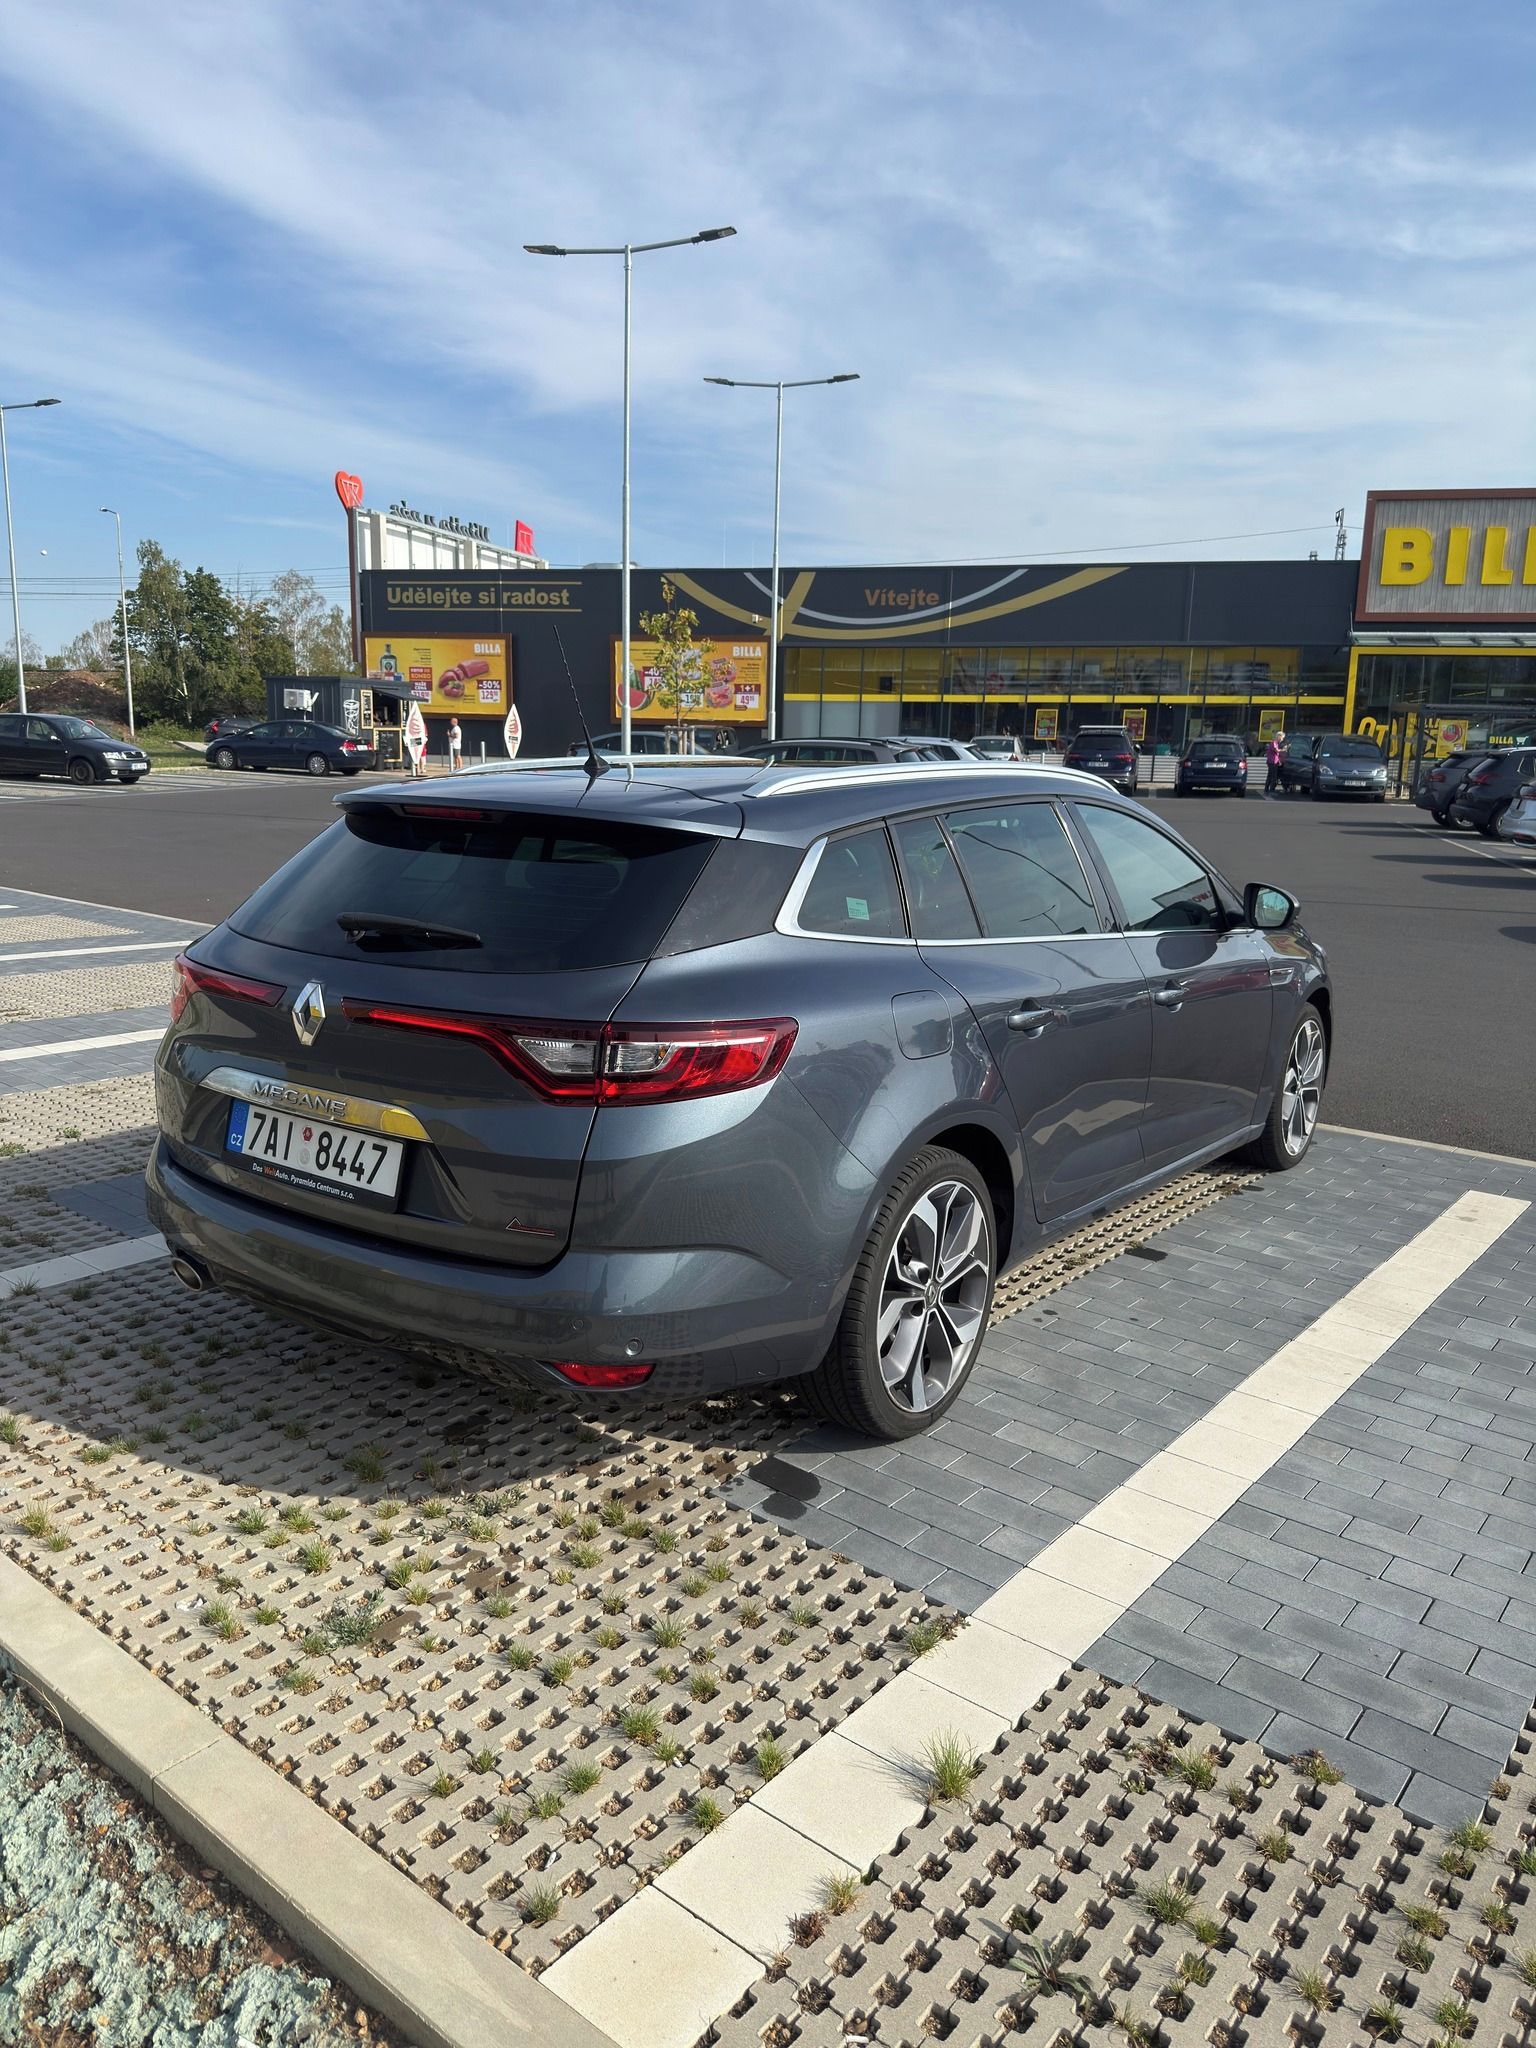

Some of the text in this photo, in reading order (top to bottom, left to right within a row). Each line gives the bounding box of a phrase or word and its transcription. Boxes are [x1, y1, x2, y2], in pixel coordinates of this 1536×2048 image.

[1380, 526, 1536, 585] BIL
[387, 587, 570, 609] Udělejte si radost
[863, 588, 940, 610] Vítejte
[474, 643, 501, 654] BILLA
[733, 646, 762, 657] BILLA
[478, 680, 500, 689] -50%
[1489, 736, 1514, 745] BILLA
[252, 1080, 347, 1117] MEGANE
[230, 1133, 242, 1147] CZ
[315, 1131, 388, 1185] 8447
[252, 1163, 263, 1173] Das
[290, 1174, 316, 1188] Pyramida
[316, 1182, 340, 1195] Centrum
